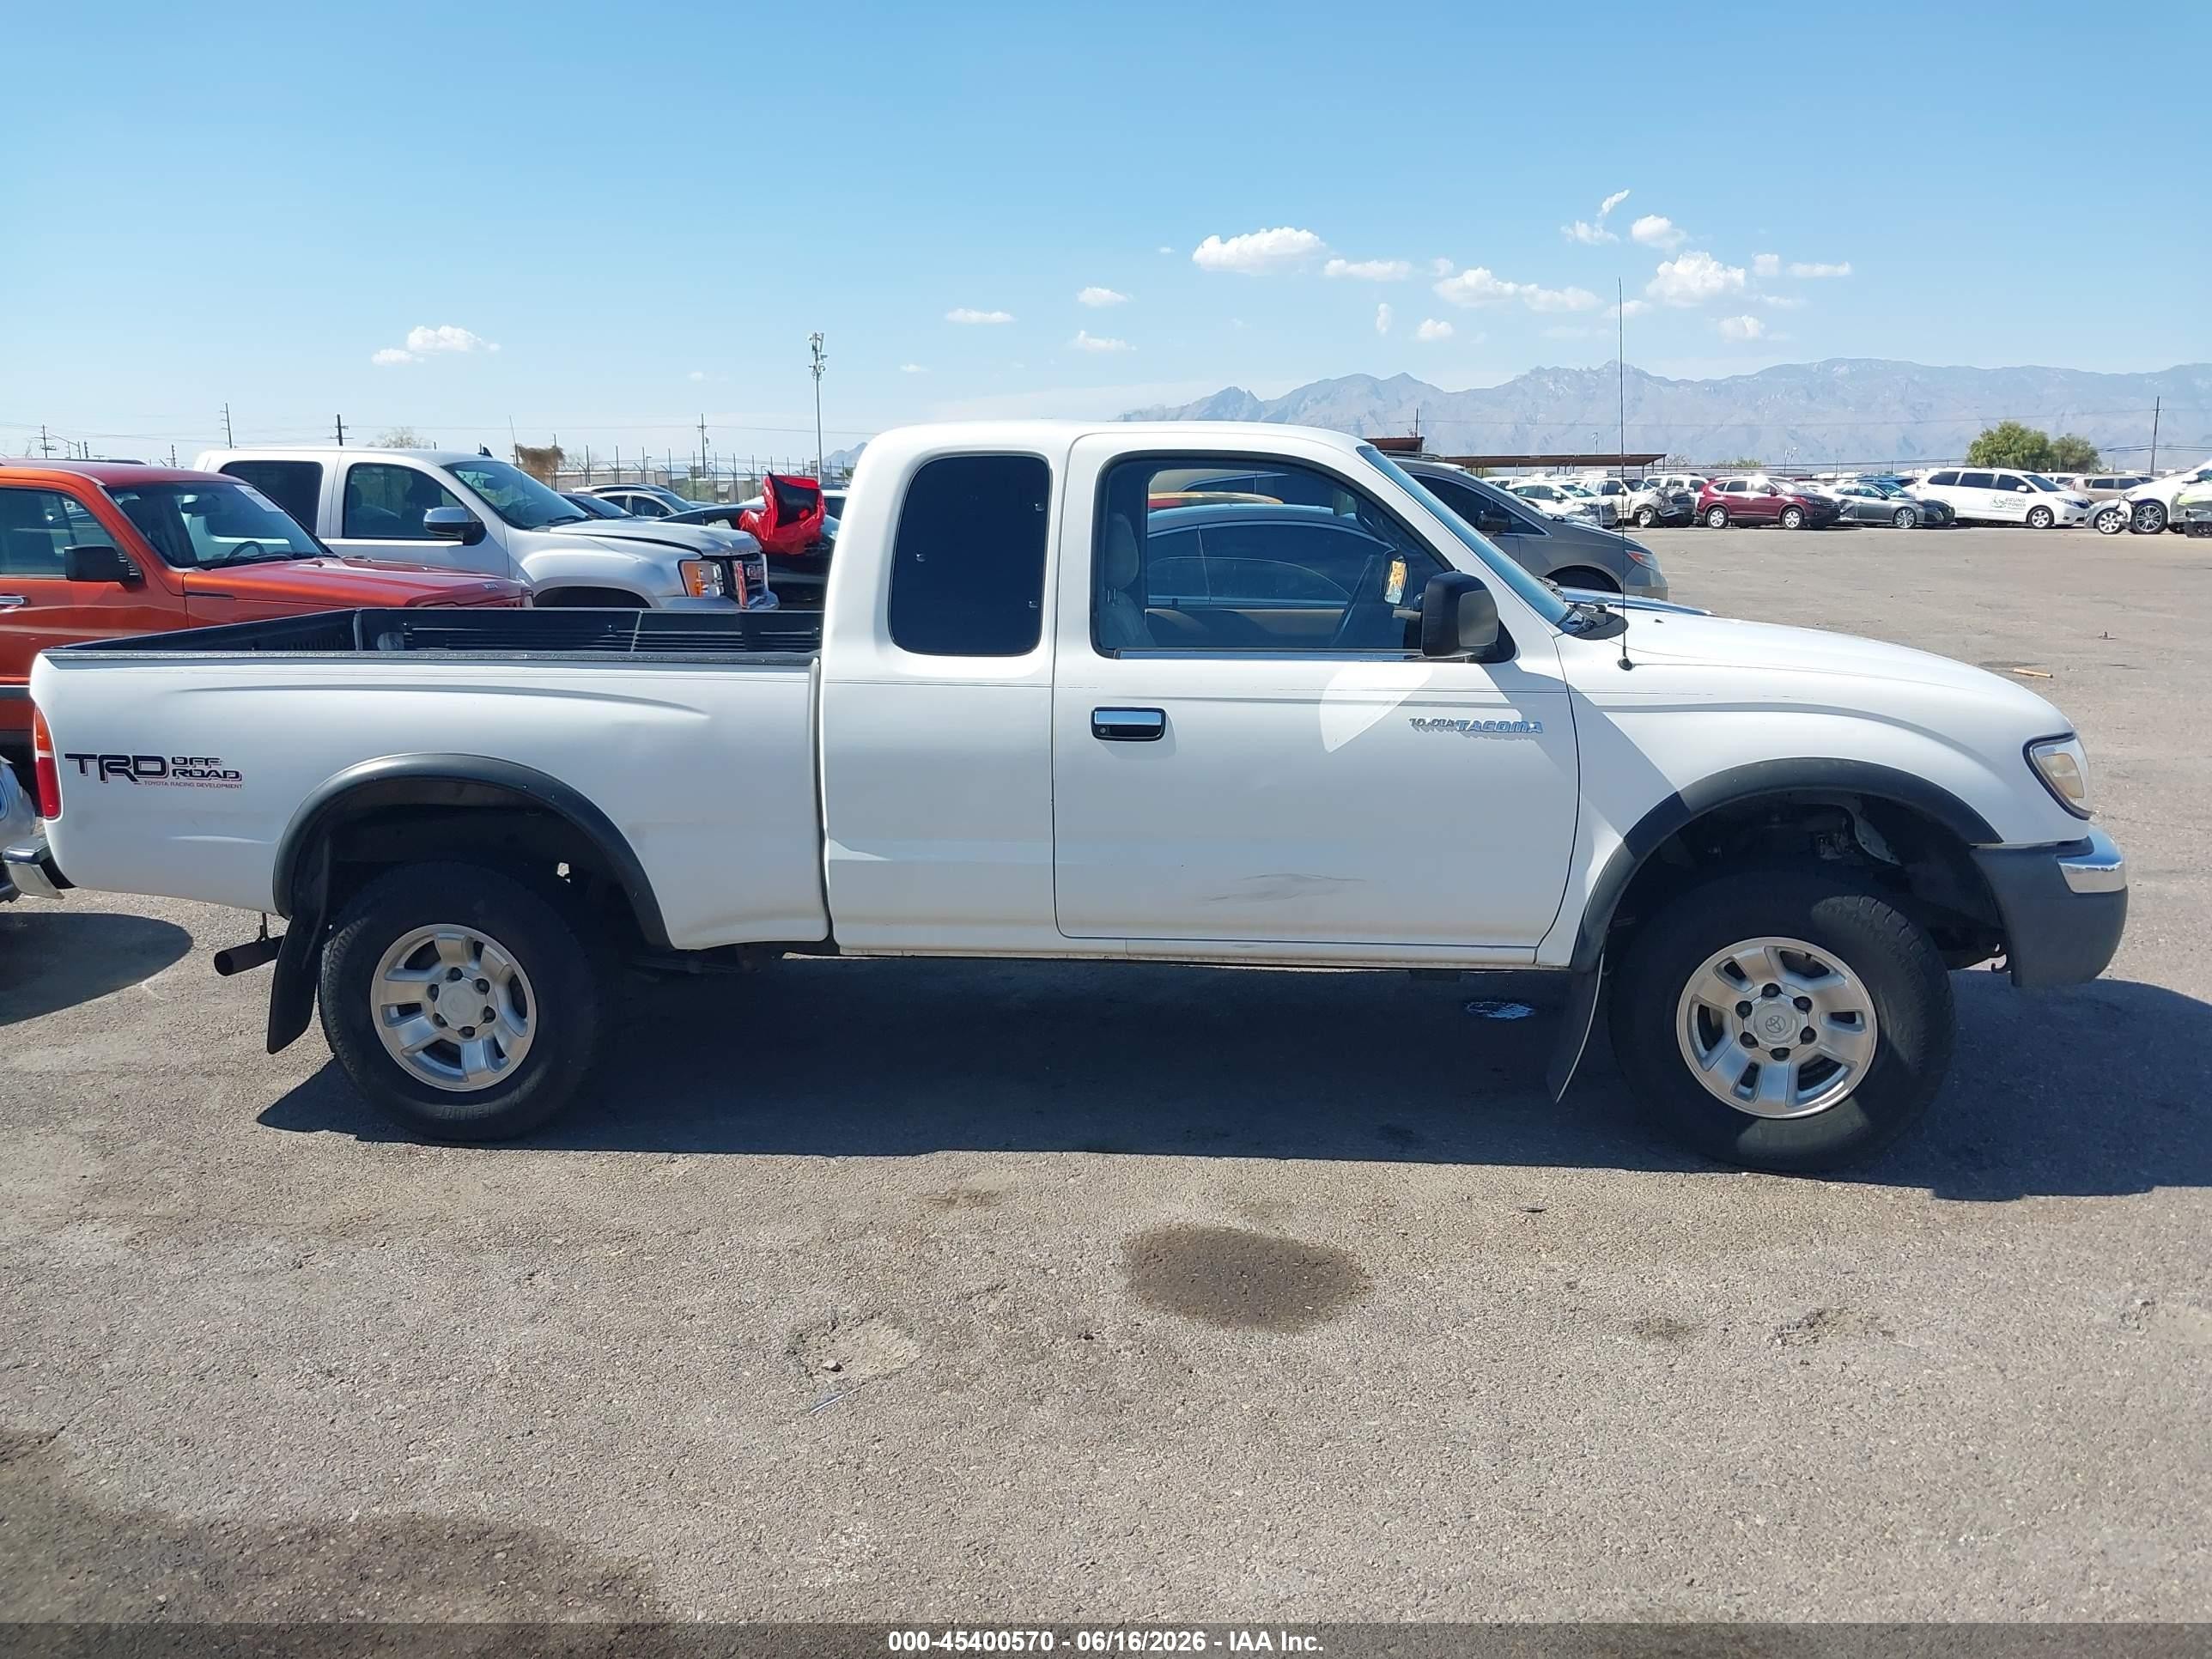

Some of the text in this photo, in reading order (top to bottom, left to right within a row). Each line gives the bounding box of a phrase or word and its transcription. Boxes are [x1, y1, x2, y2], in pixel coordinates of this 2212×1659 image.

[1455, 720, 1544, 733] TACOMA
[64, 753, 169, 785] TRD
[172, 757, 222, 769] OFF
[172, 769, 243, 782] ROAD
